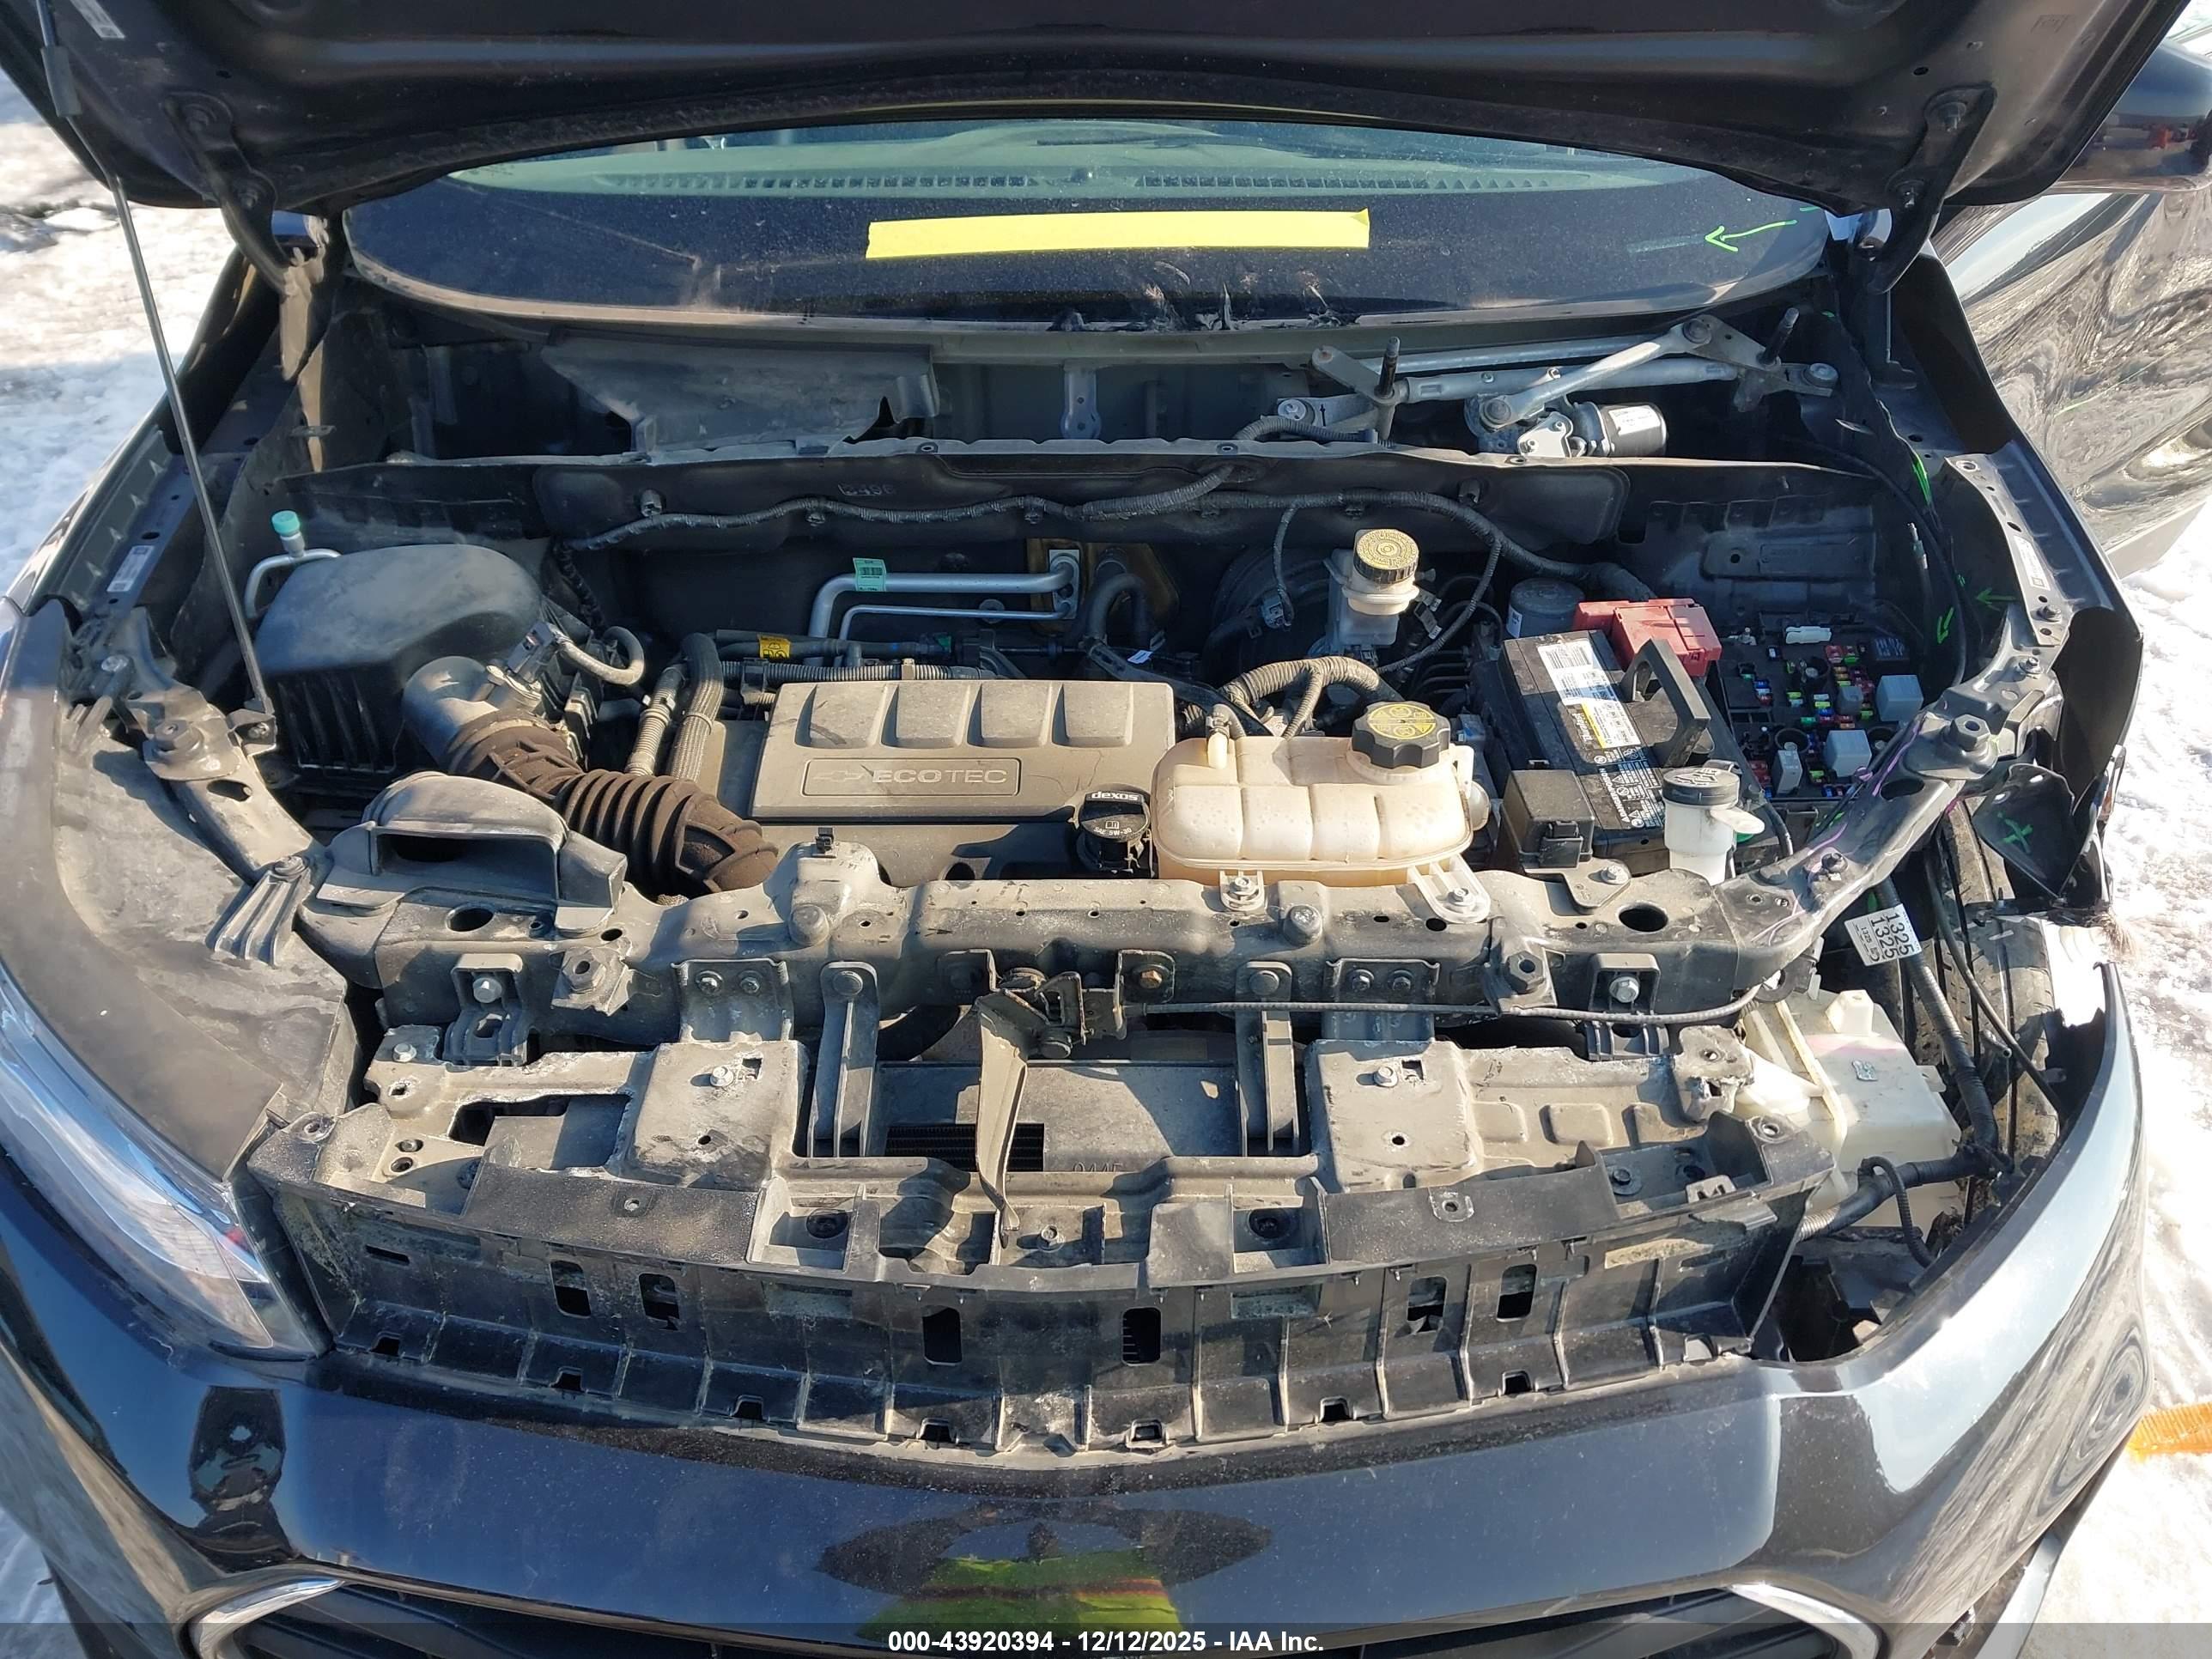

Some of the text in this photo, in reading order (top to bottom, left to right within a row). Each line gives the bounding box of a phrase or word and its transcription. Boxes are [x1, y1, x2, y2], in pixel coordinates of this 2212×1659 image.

[872, 769, 1008, 784] ECOTEC
[1091, 791, 1139, 801] dexos
[1093, 826, 1133, 836] SAE 5W-30
[1861, 927, 1872, 944] 1325
[1870, 916, 1900, 959] 1325
[1884, 912, 1915, 955] 1325
